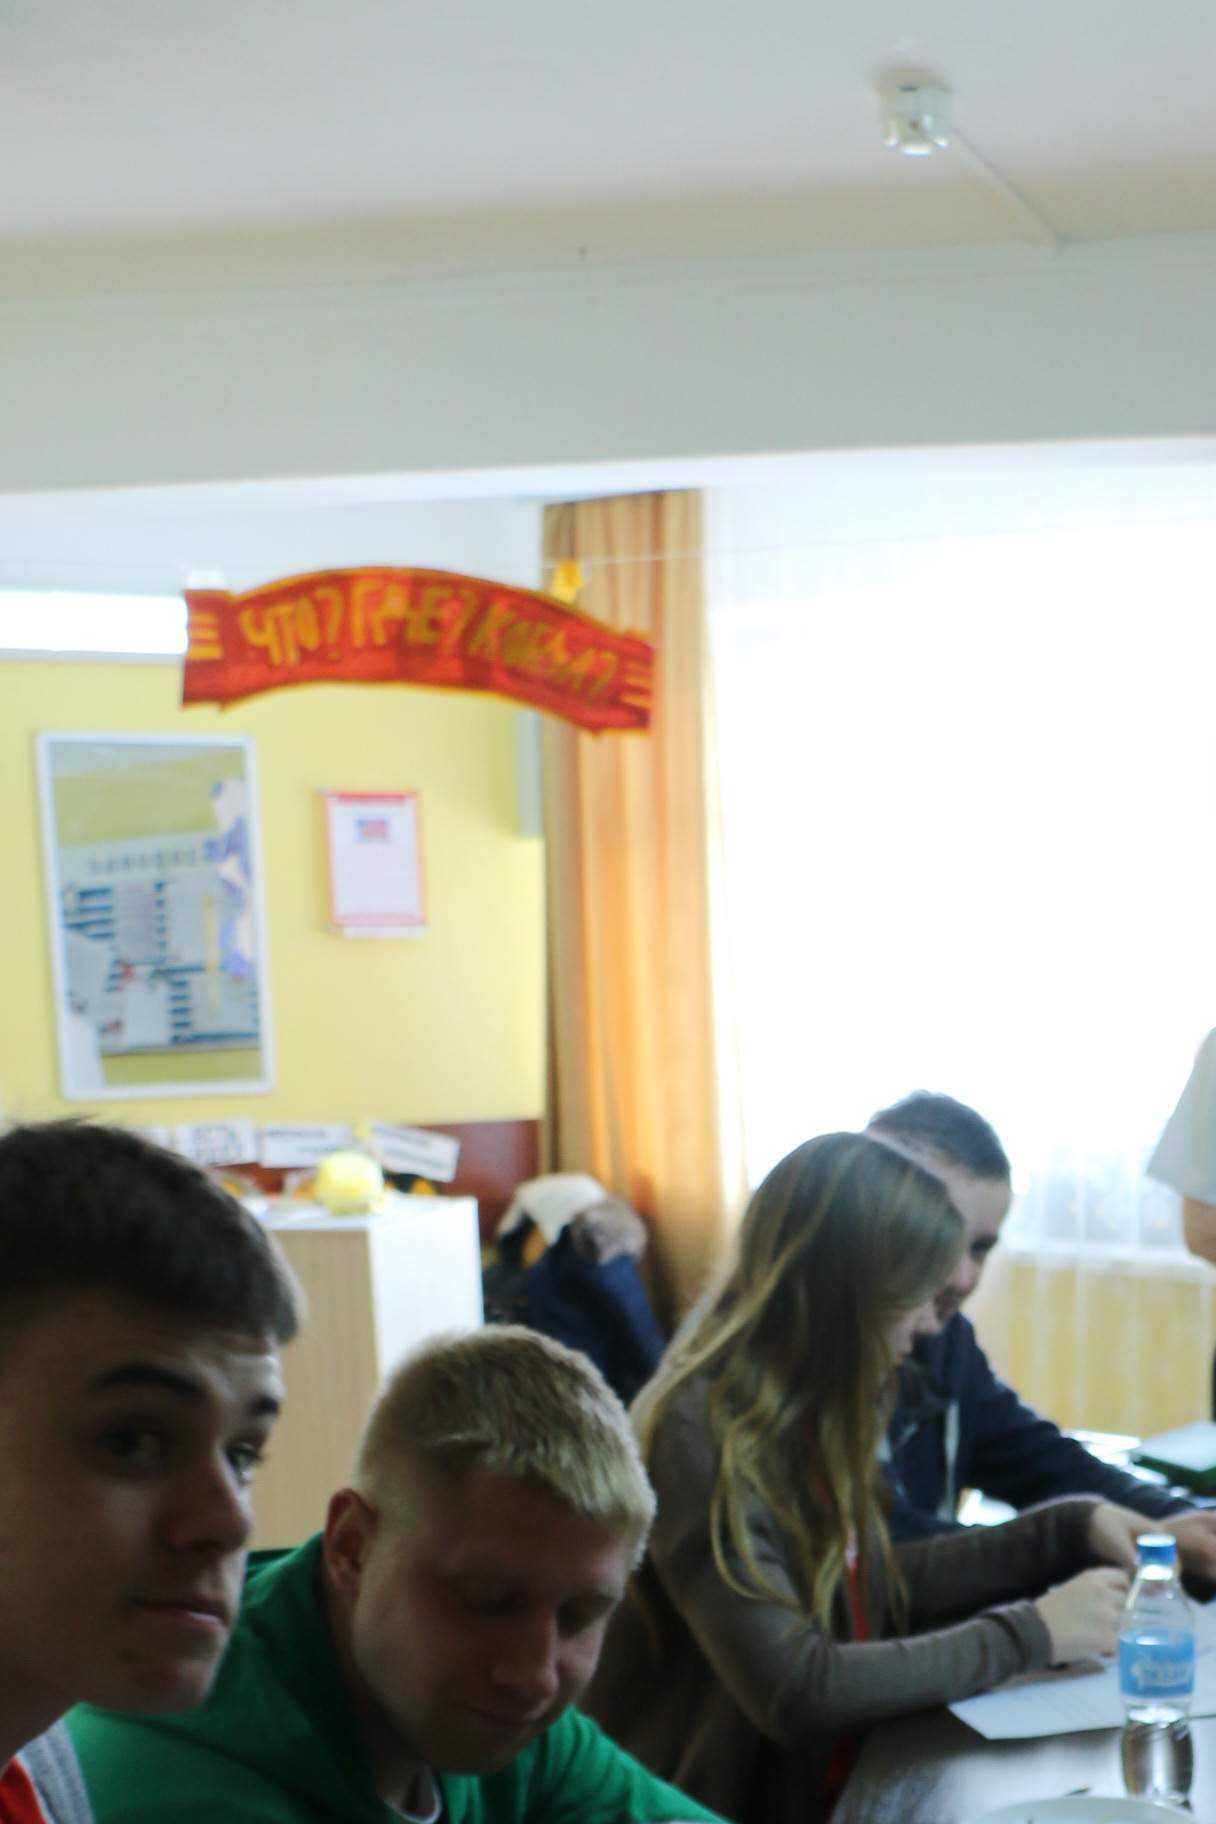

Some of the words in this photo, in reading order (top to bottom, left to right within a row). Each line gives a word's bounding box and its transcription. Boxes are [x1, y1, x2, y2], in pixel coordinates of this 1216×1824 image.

[239, 586, 343, 668] ЧТО?
[350, 577, 479, 658] ГДЕ?
[467, 602, 620, 704] КОГДА?
